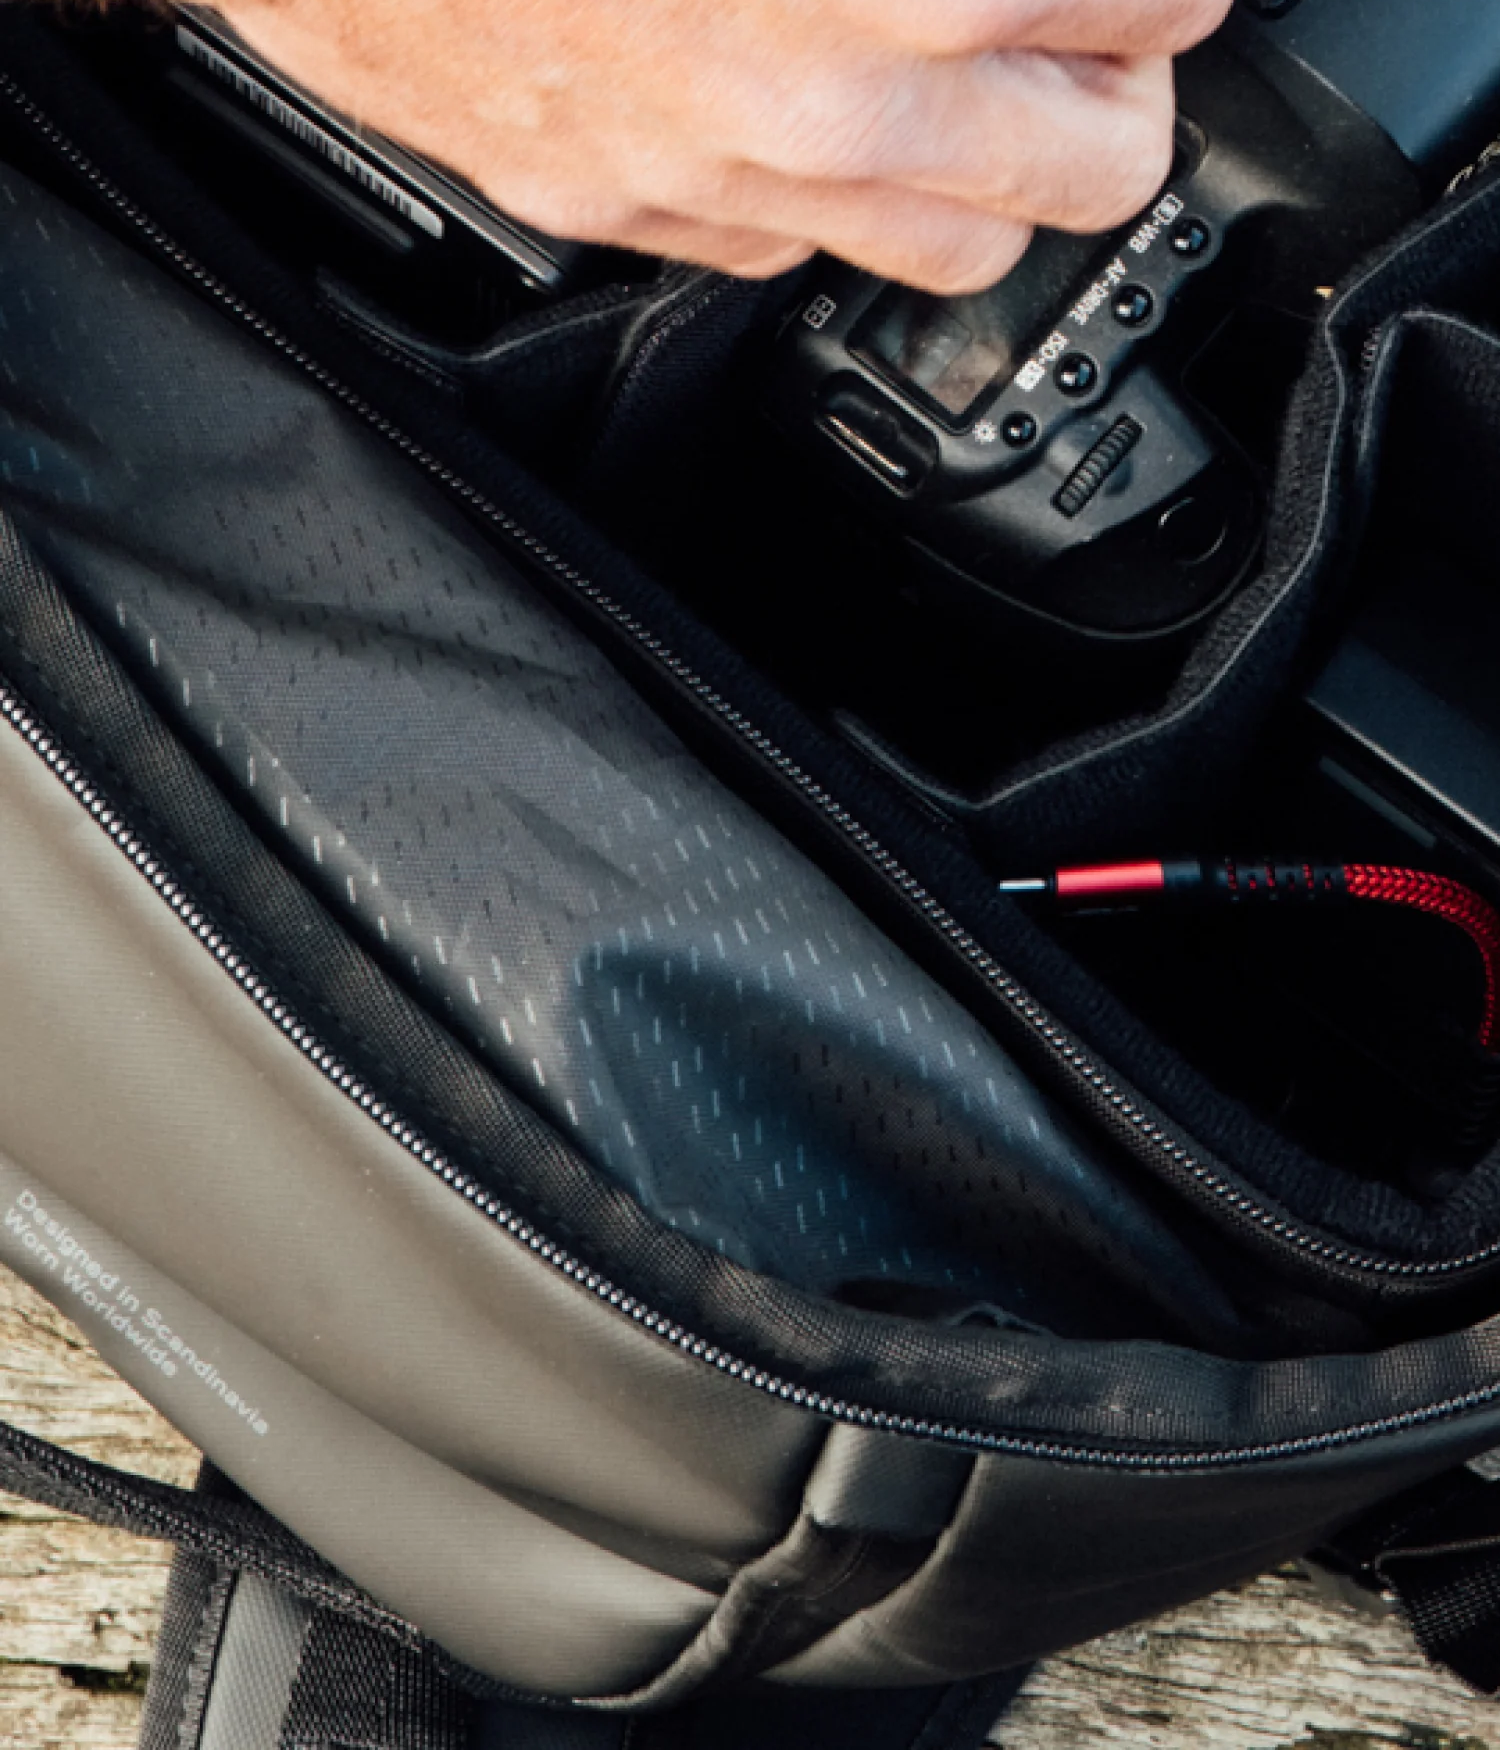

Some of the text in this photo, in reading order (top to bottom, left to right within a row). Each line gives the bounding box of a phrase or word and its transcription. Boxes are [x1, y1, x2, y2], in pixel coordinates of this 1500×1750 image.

[5, 1206, 178, 1379] Worn Worldwide
[16, 1188, 120, 1291] Designed
[141, 1307, 269, 1436] Scandinavia
